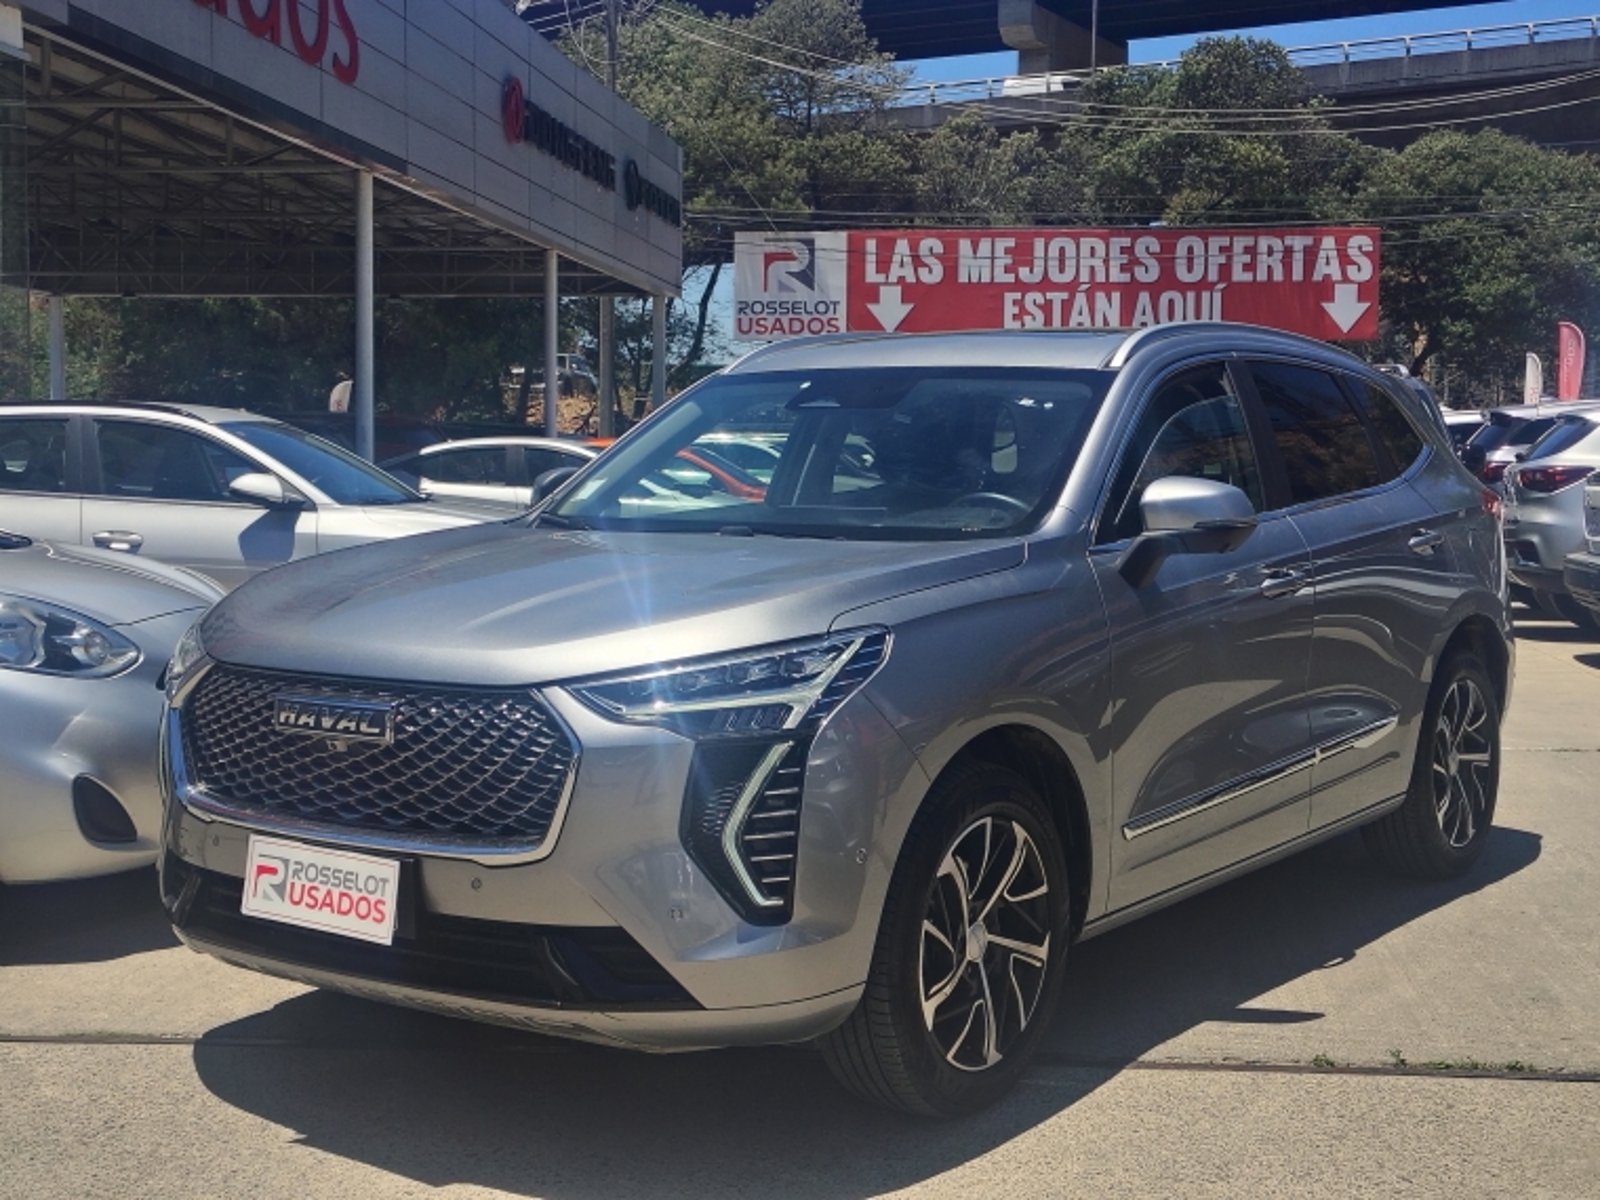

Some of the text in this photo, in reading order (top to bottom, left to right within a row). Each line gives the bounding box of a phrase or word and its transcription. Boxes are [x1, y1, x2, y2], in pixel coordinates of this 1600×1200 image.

[865, 235, 1374, 284] LAS MEJORES OFERTAS
[737, 300, 840, 316] ROSSELOT
[1003, 284, 1120, 329] ESTÁN
[737, 317, 840, 335] USADOS
[279, 703, 381, 733] HAVAL
[291, 861, 390, 897] ROSSELOT
[288, 882, 387, 924] USADOS
